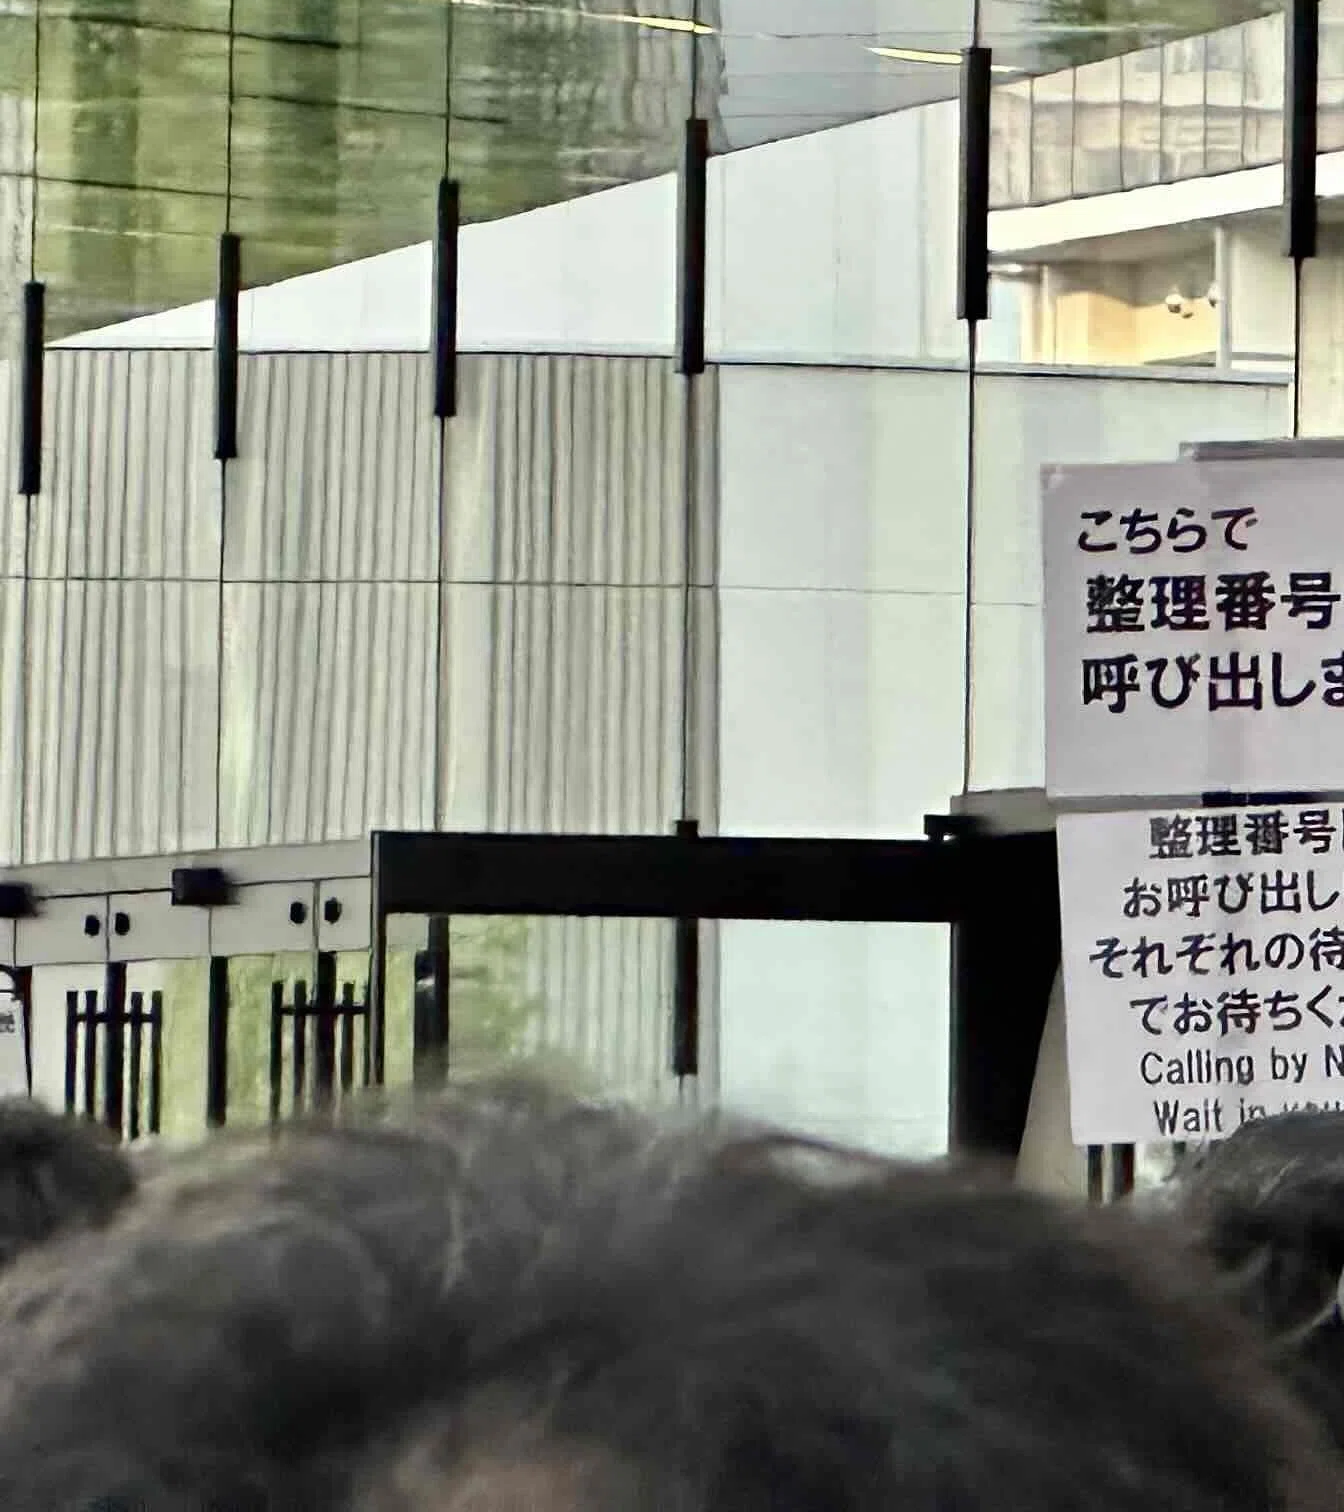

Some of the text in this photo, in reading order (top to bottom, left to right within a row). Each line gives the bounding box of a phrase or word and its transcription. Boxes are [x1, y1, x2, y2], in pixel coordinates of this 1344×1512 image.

[1077, 506, 1258, 555] こちらで
[1140, 1049, 1254, 1086] Calling
[1271, 1046, 1308, 1089] by
[1153, 1098, 1222, 1135] Wait
